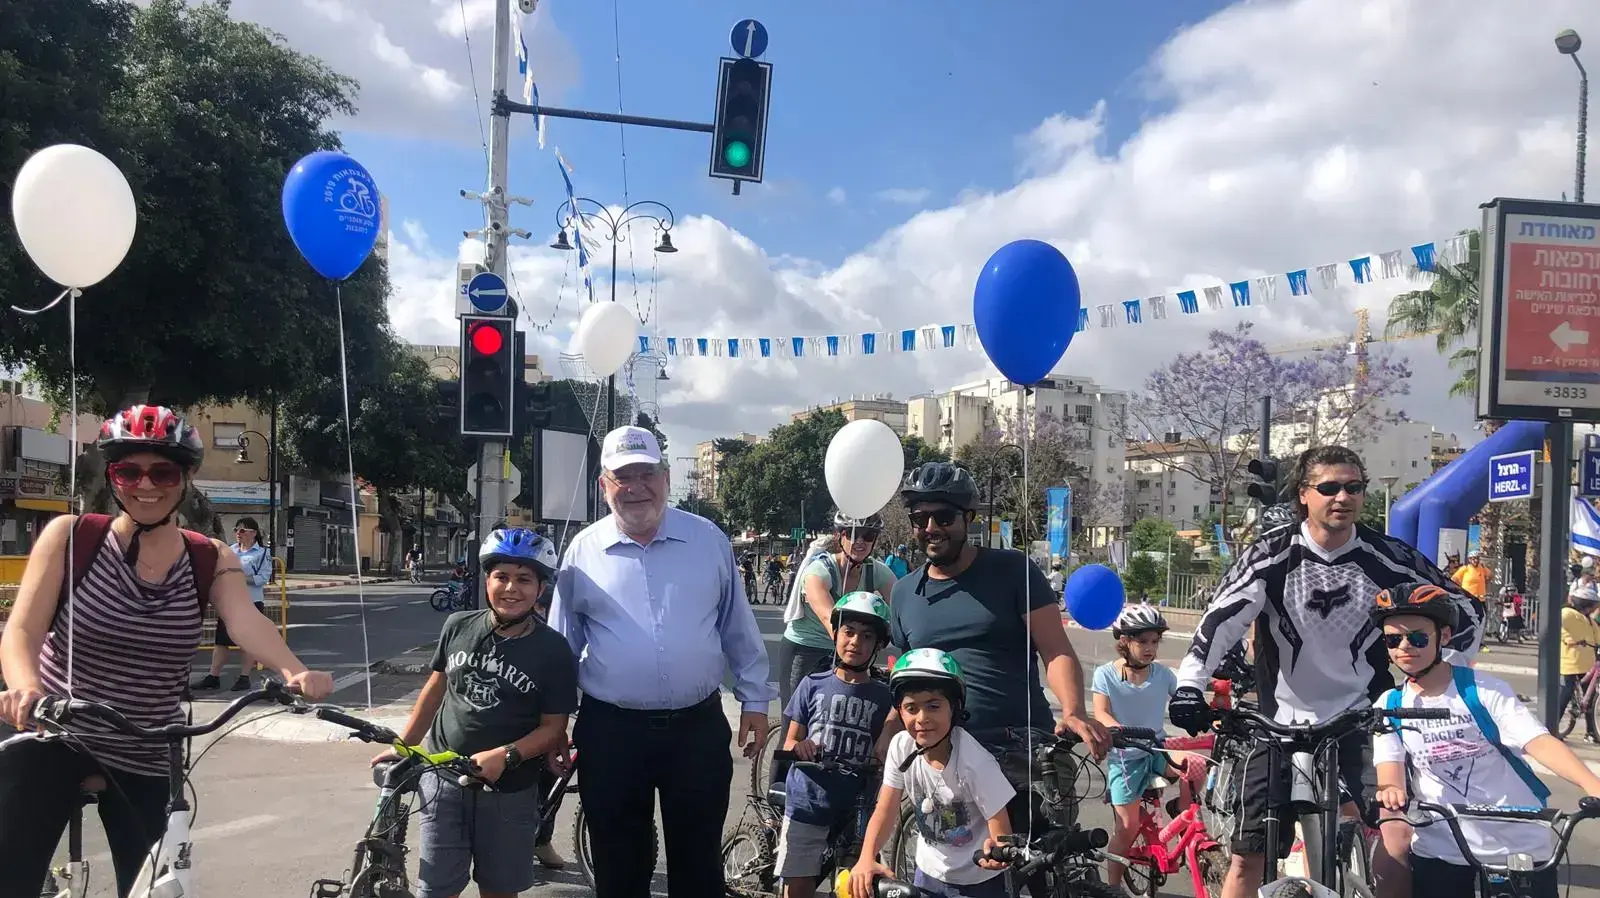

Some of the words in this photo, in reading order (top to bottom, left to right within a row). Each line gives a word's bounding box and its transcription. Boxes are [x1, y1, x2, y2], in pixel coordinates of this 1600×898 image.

[1518, 221, 1596, 240] מאוחדת
[1497, 463, 1520, 476] הרצל
[1494, 480, 1520, 493] HERZL
[1422, 728, 1465, 744] EAGLE
